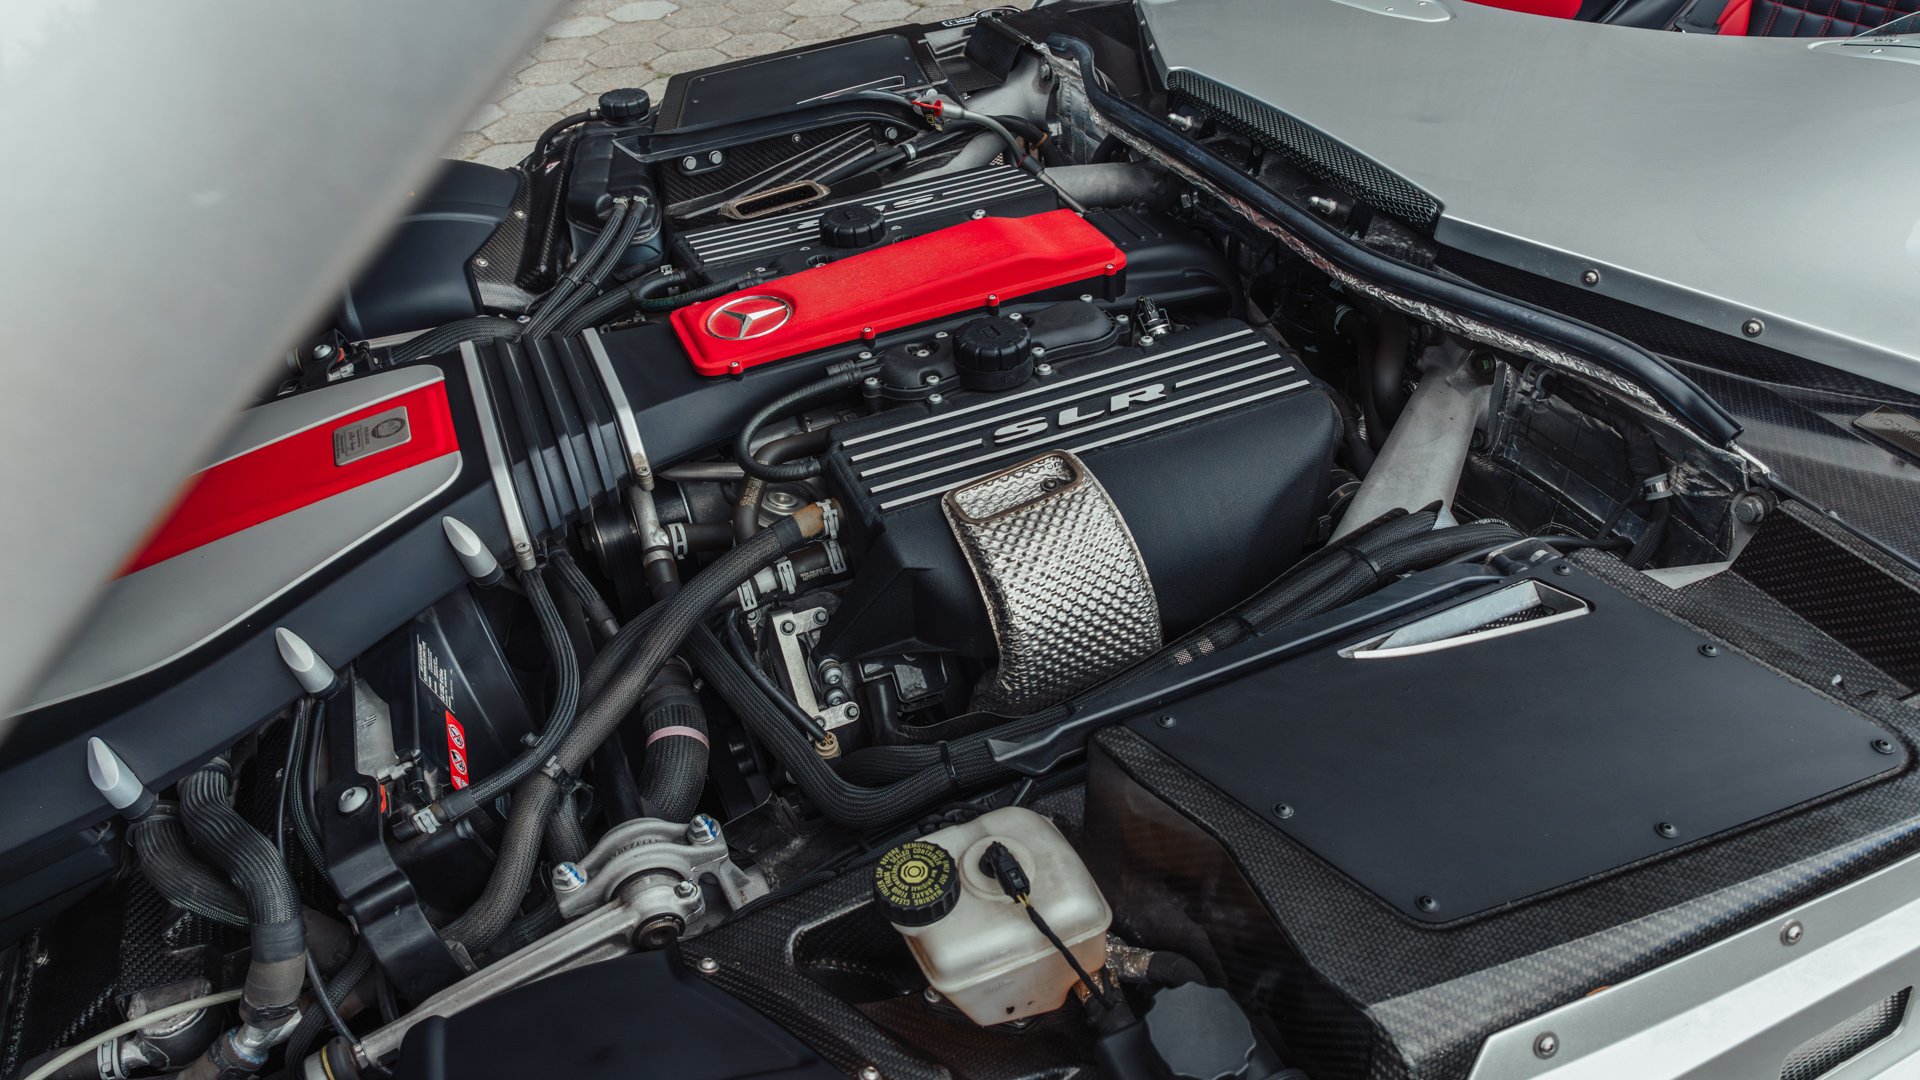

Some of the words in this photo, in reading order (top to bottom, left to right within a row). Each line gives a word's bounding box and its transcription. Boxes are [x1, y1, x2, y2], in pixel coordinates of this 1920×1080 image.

[995, 383, 1167, 443] SLR
[880, 847, 900, 865] BEFORE
[890, 850, 909, 863] SEALED
[913, 849, 943, 865] CONTAINER
[884, 871, 893, 887] FROM
[877, 880, 890, 896] FILLER
[891, 885, 908, 898] FLUID
[912, 889, 934, 899] BRAKE
[890, 895, 910, 905] CLEAN
[914, 889, 943, 905] WARNING
